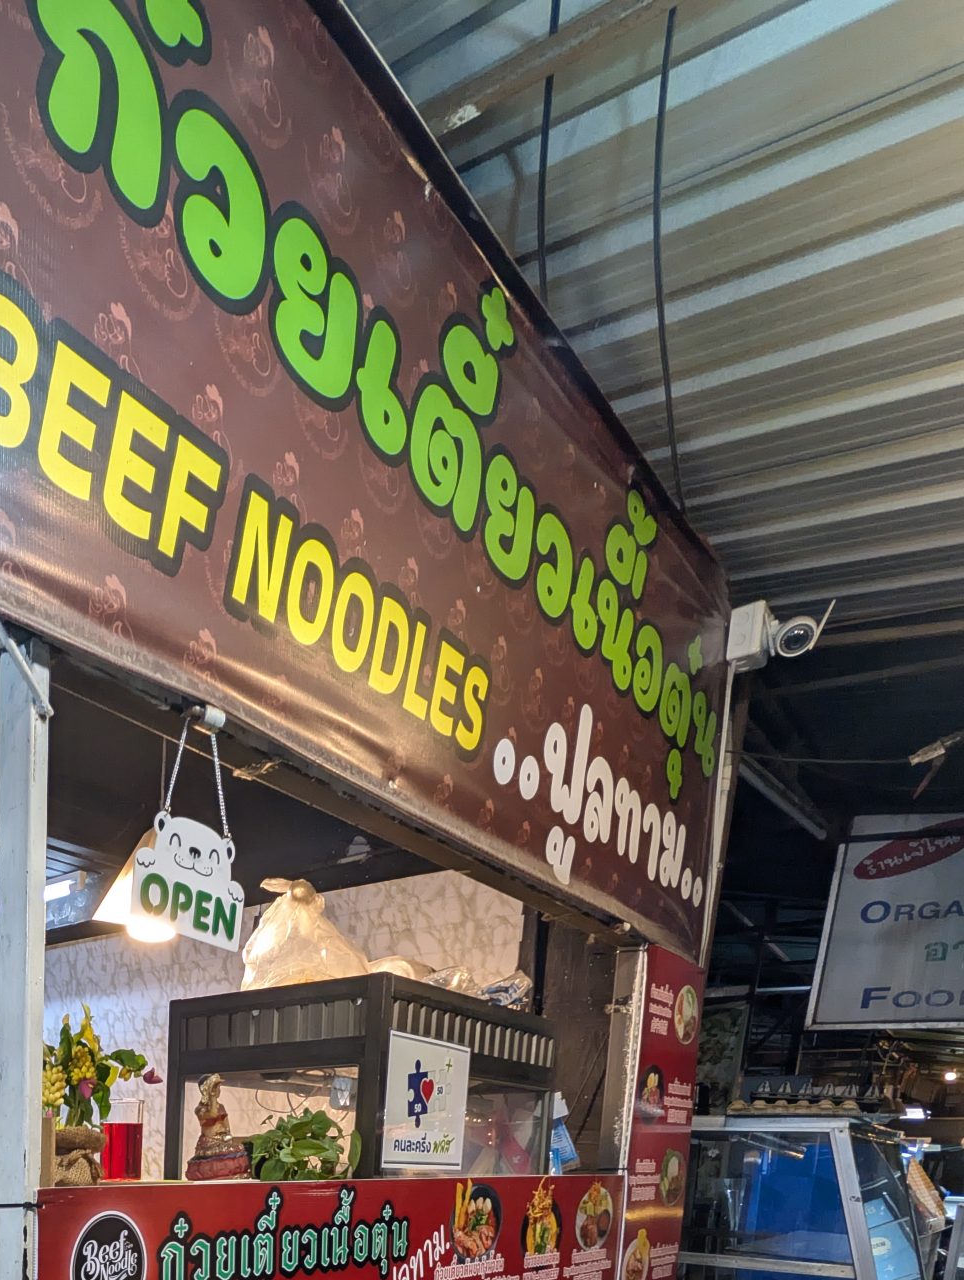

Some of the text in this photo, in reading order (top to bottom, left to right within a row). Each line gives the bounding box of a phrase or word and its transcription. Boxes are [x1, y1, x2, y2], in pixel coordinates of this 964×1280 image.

[232, 490, 489, 751] NOODLES
[140, 872, 237, 941] OPEN
[414, 1103, 422, 1113] 50
[393, 1132, 432, 1154] คนละครึ่ง
